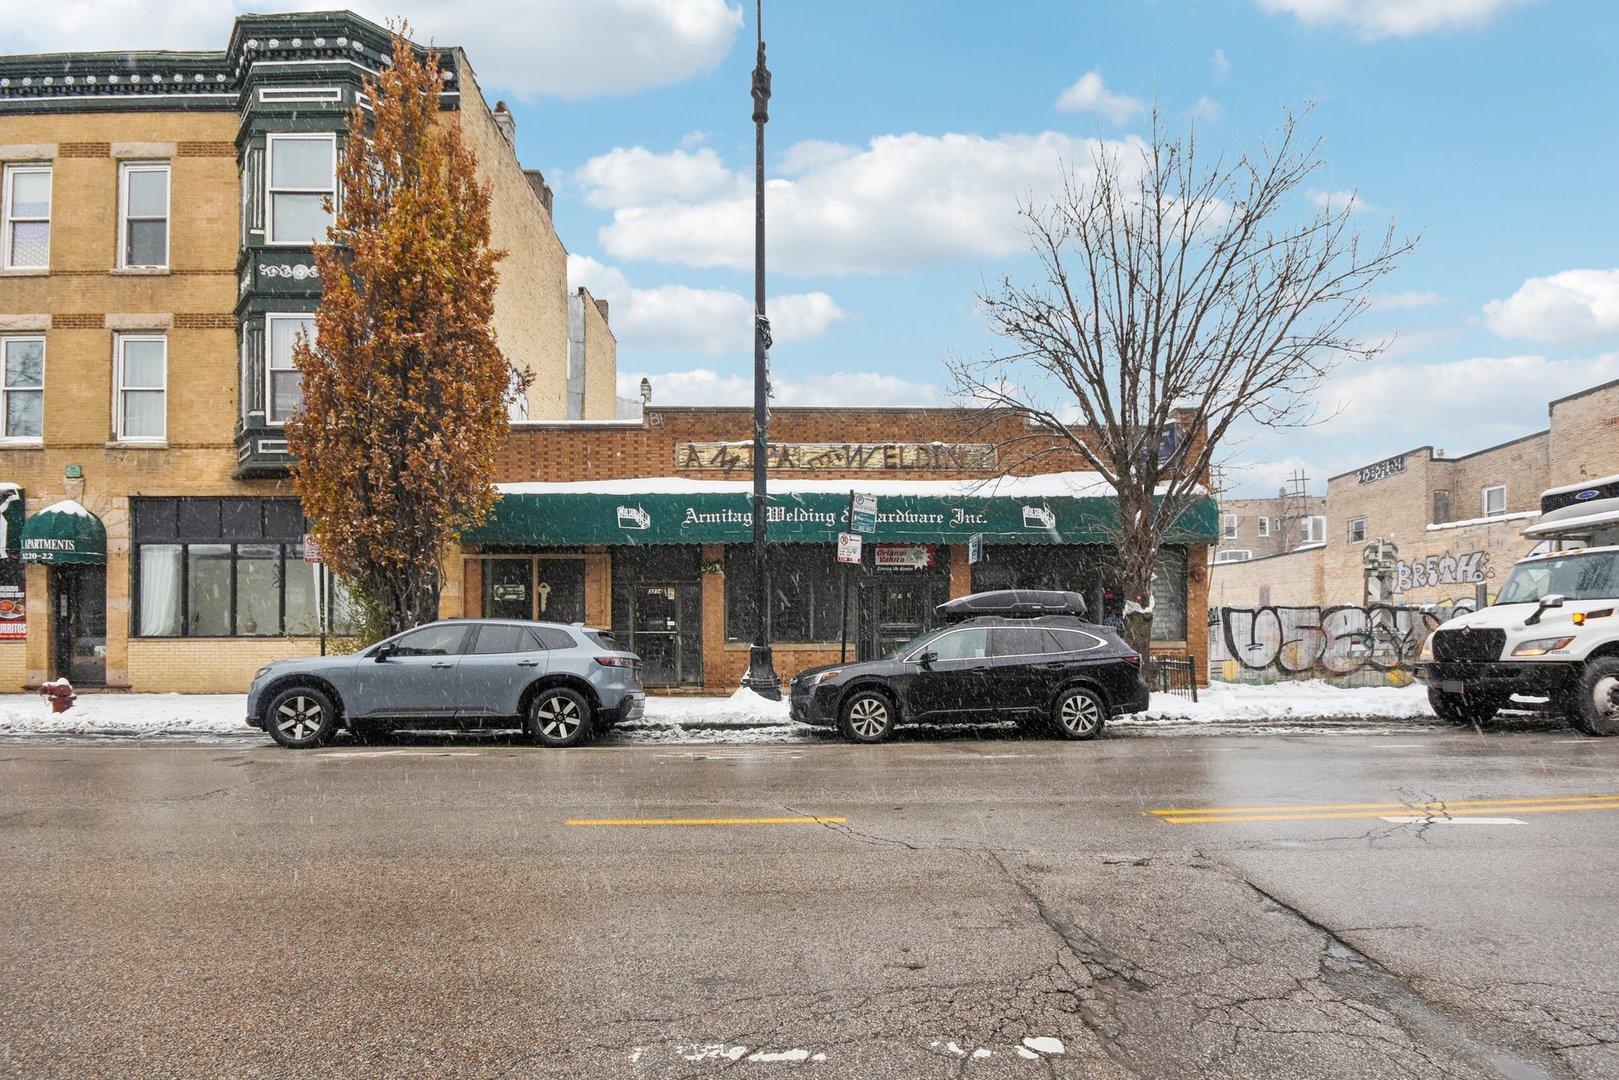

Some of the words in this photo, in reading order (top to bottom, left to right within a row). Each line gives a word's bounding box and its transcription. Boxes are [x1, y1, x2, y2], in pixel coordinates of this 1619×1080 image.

[681, 507, 753, 528] Armitag
[766, 506, 836, 527] Welding
[875, 508, 945, 523] ardware
[949, 507, 989, 528] Inc.
[877, 549, 907, 557] Orlandi
